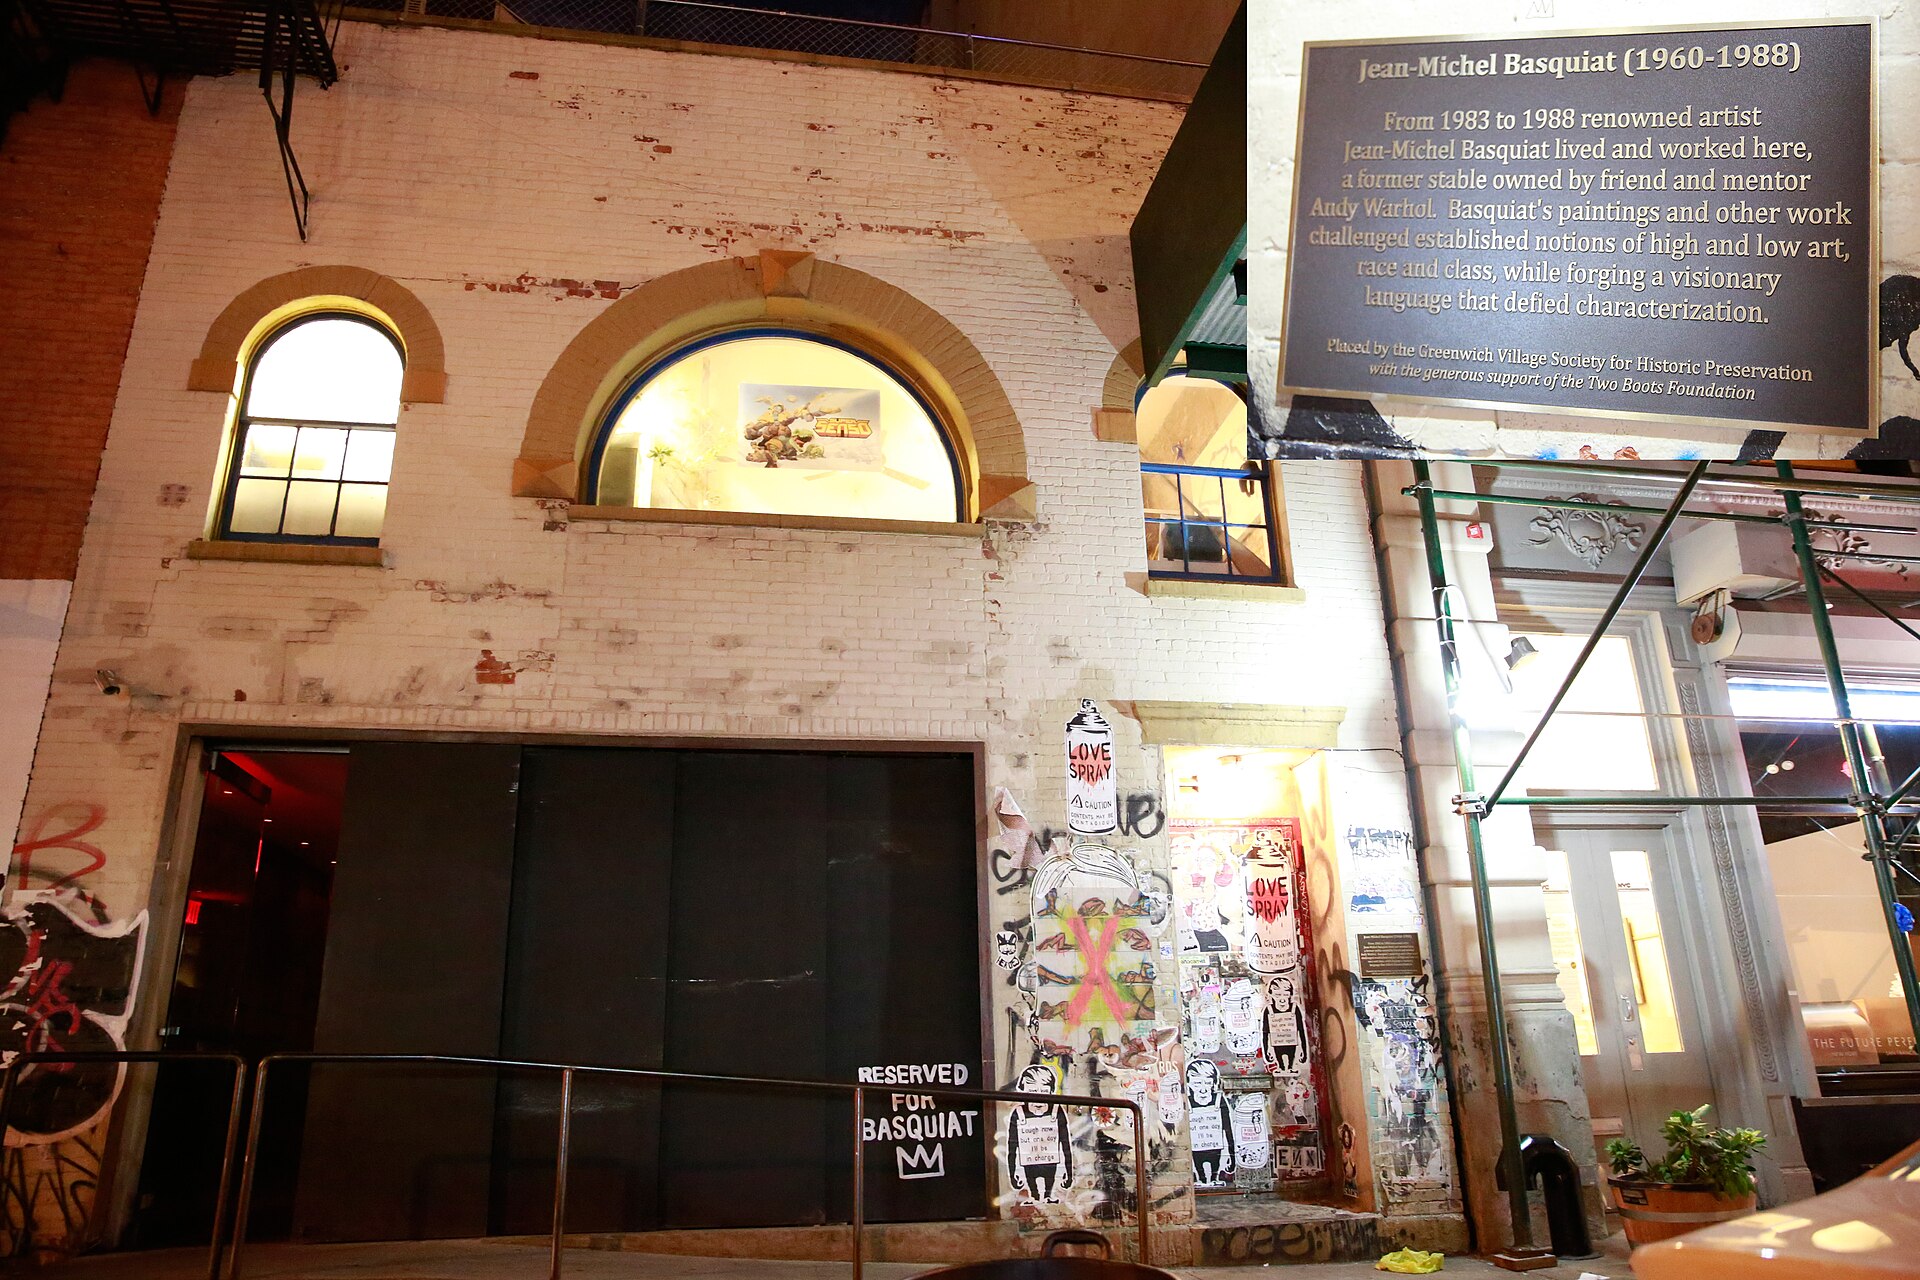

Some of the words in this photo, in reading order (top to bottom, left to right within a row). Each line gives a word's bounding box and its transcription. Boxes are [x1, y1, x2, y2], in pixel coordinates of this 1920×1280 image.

[1358, 53, 1497, 83] Jean-Michel
[1504, 50, 1616, 79] Basquiat
[1623, 42, 1801, 76] (1960-1988)
[1384, 111, 1434, 131] From
[1441, 110, 1490, 130] 1983
[1496, 112, 1516, 130] to
[1522, 108, 1575, 129] 1988
[1581, 106, 1692, 128] renowned
[1699, 106, 1762, 126] artist
[1344, 139, 1454, 164] Jean-Michel
[1461, 140, 1550, 164] Basquiat
[1555, 138, 1606, 159] lived
[1612, 138, 1652, 159] and
[1659, 136, 1745, 159] worked
[1753, 136, 1812, 162] here,
[1342, 174, 1353, 190] a
[1358, 169, 1423, 189] former
[1428, 170, 1486, 190] stable
[1492, 169, 1562, 190] owned
[1569, 169, 1595, 196] by
[1600, 169, 1667, 191] friend
[1673, 169, 1716, 191] and
[1723, 171, 1811, 192] mentor
[1310, 198, 1358, 221] Andy
[1363, 198, 1436, 218] Warhol.
[1448, 199, 1552, 226] Basquiat's
[1558, 200, 1660, 228] paintings
[1666, 200, 1709, 224] and
[1716, 200, 1780, 224] other
[1786, 202, 1852, 225] work
[1309, 226, 1409, 252] challenged
[1414, 228, 1529, 251] established
[1535, 232, 1615, 253] notions
[1622, 232, 1646, 253] of
[1650, 232, 1698, 260] high
[1706, 233, 1750, 257] and
[1757, 234, 1801, 257] low
[1807, 238, 1850, 263] art,
[1357, 260, 1397, 276] race
[1402, 259, 1438, 279] and
[1444, 261, 1498, 283] class,
[1503, 262, 1560, 284] while
[1567, 262, 1646, 292] forging
[1652, 271, 1664, 287] a
[1671, 267, 1781, 296] visionary
[1364, 285, 1452, 314] language
[1457, 290, 1499, 312] that
[1504, 291, 1569, 316] defied
[1576, 294, 1769, 324] characterization.
[1328, 339, 1370, 354] Placed
[1374, 341, 1390, 358] by
[1393, 343, 1414, 358] the
[1419, 344, 1493, 363] Greenwich
[1497, 349, 1547, 368] Village
[1551, 352, 1606, 372] Society
[1609, 354, 1632, 370] for
[1638, 357, 1700, 375] Historic
[1706, 361, 1813, 382] Preservation
[1369, 363, 1397, 378] with
[1401, 365, 1421, 378] the
[1424, 367, 1484, 383] generous
[1487, 371, 1540, 387] support
[1544, 373, 1558, 390] of
[1561, 374, 1583, 389] the
[1588, 376, 1618, 391] Two
[1622, 378, 1664, 394] Boots
[1667, 381, 1756, 400] Foundation
[1069, 741, 1111, 760] LOVE
[1070, 763, 1111, 782] SPRAY
[1085, 801, 1111, 809] CAUTION
[1245, 876, 1288, 896] LOVE
[1247, 900, 1288, 919] SPRAY
[1264, 940, 1291, 948] CAUTION
[1814, 1038, 1835, 1048] THE
[1840, 1037, 1882, 1048] FUTURE
[858, 1064, 968, 1085] RESERVED
[892, 1093, 936, 1112] FOR
[863, 1111, 978, 1141] BASQUIAT
